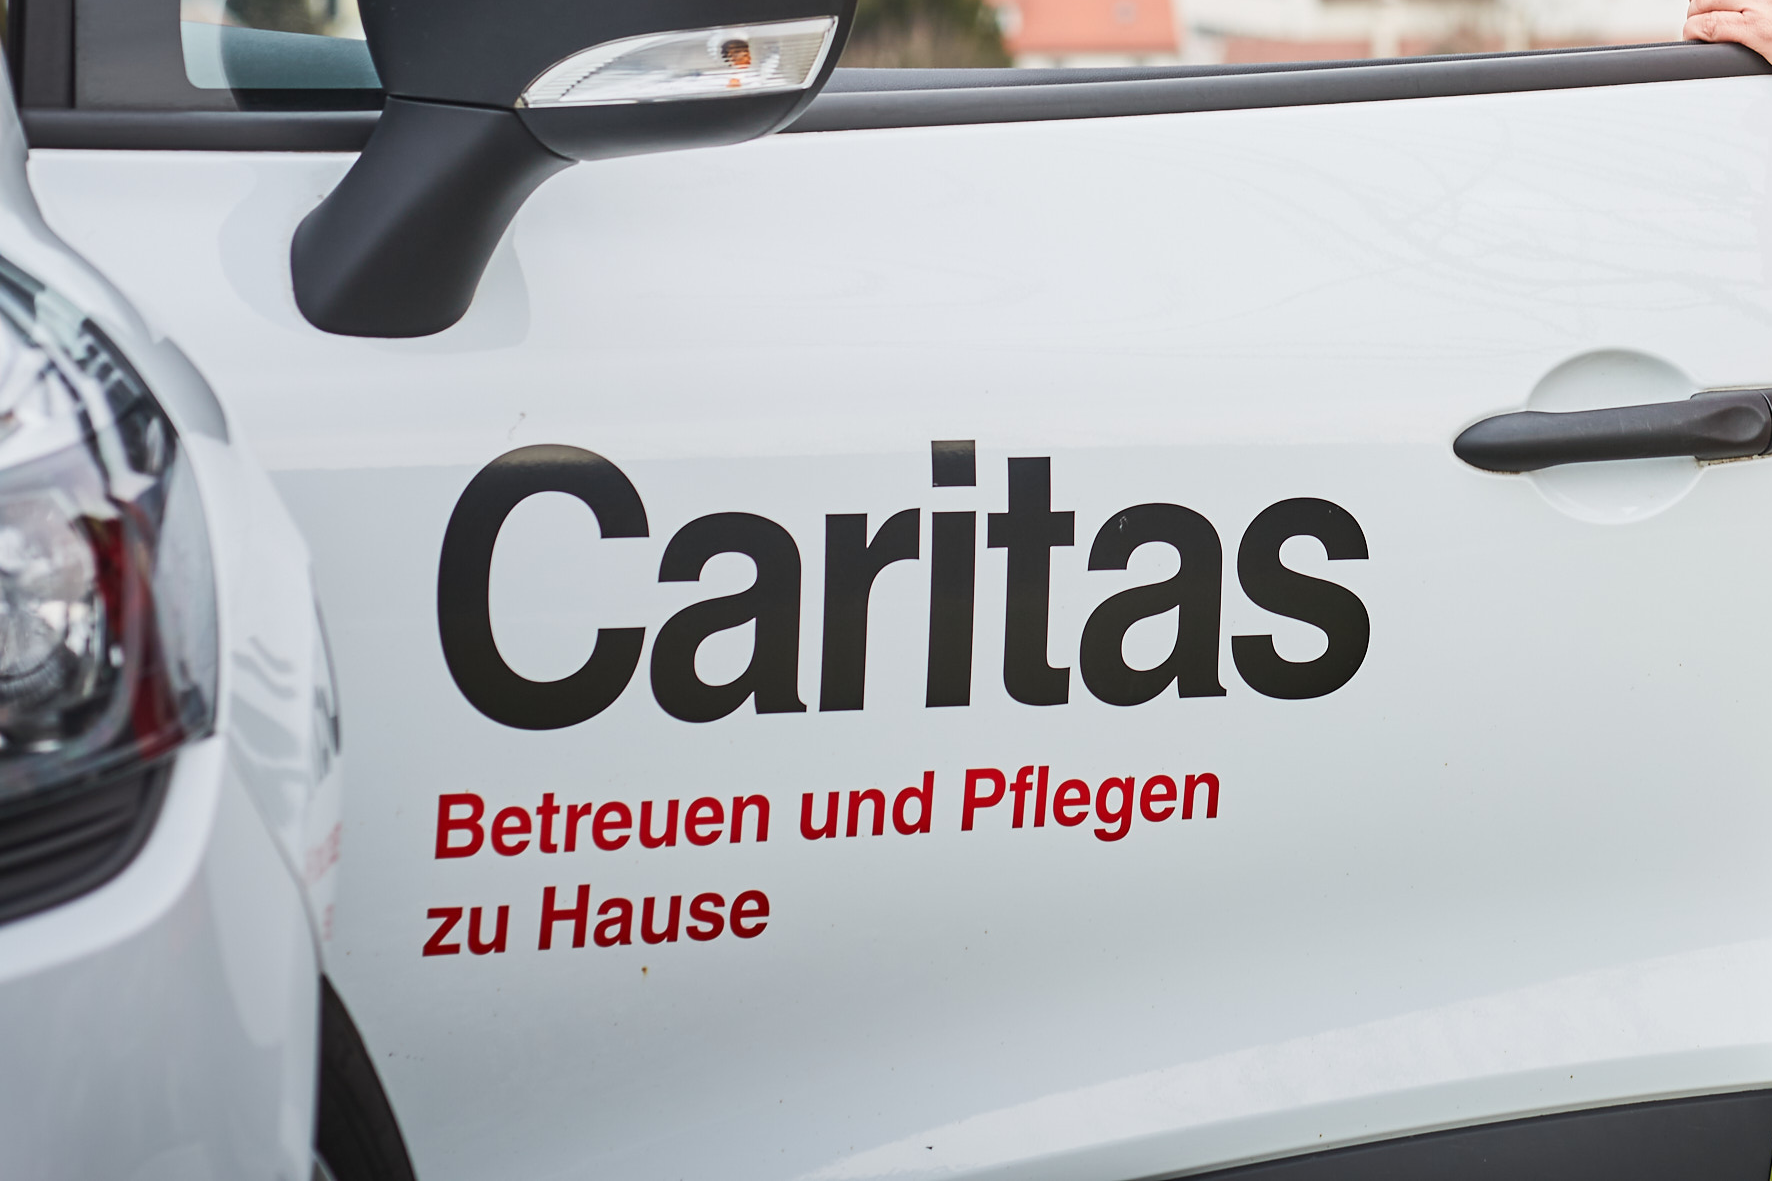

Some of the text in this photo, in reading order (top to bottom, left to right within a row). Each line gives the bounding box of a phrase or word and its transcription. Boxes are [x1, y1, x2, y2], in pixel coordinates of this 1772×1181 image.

[437, 440, 1370, 730] Caritas
[435, 765, 1220, 859] Betreuen und Pflegen
[422, 884, 770, 957] zu Hause
